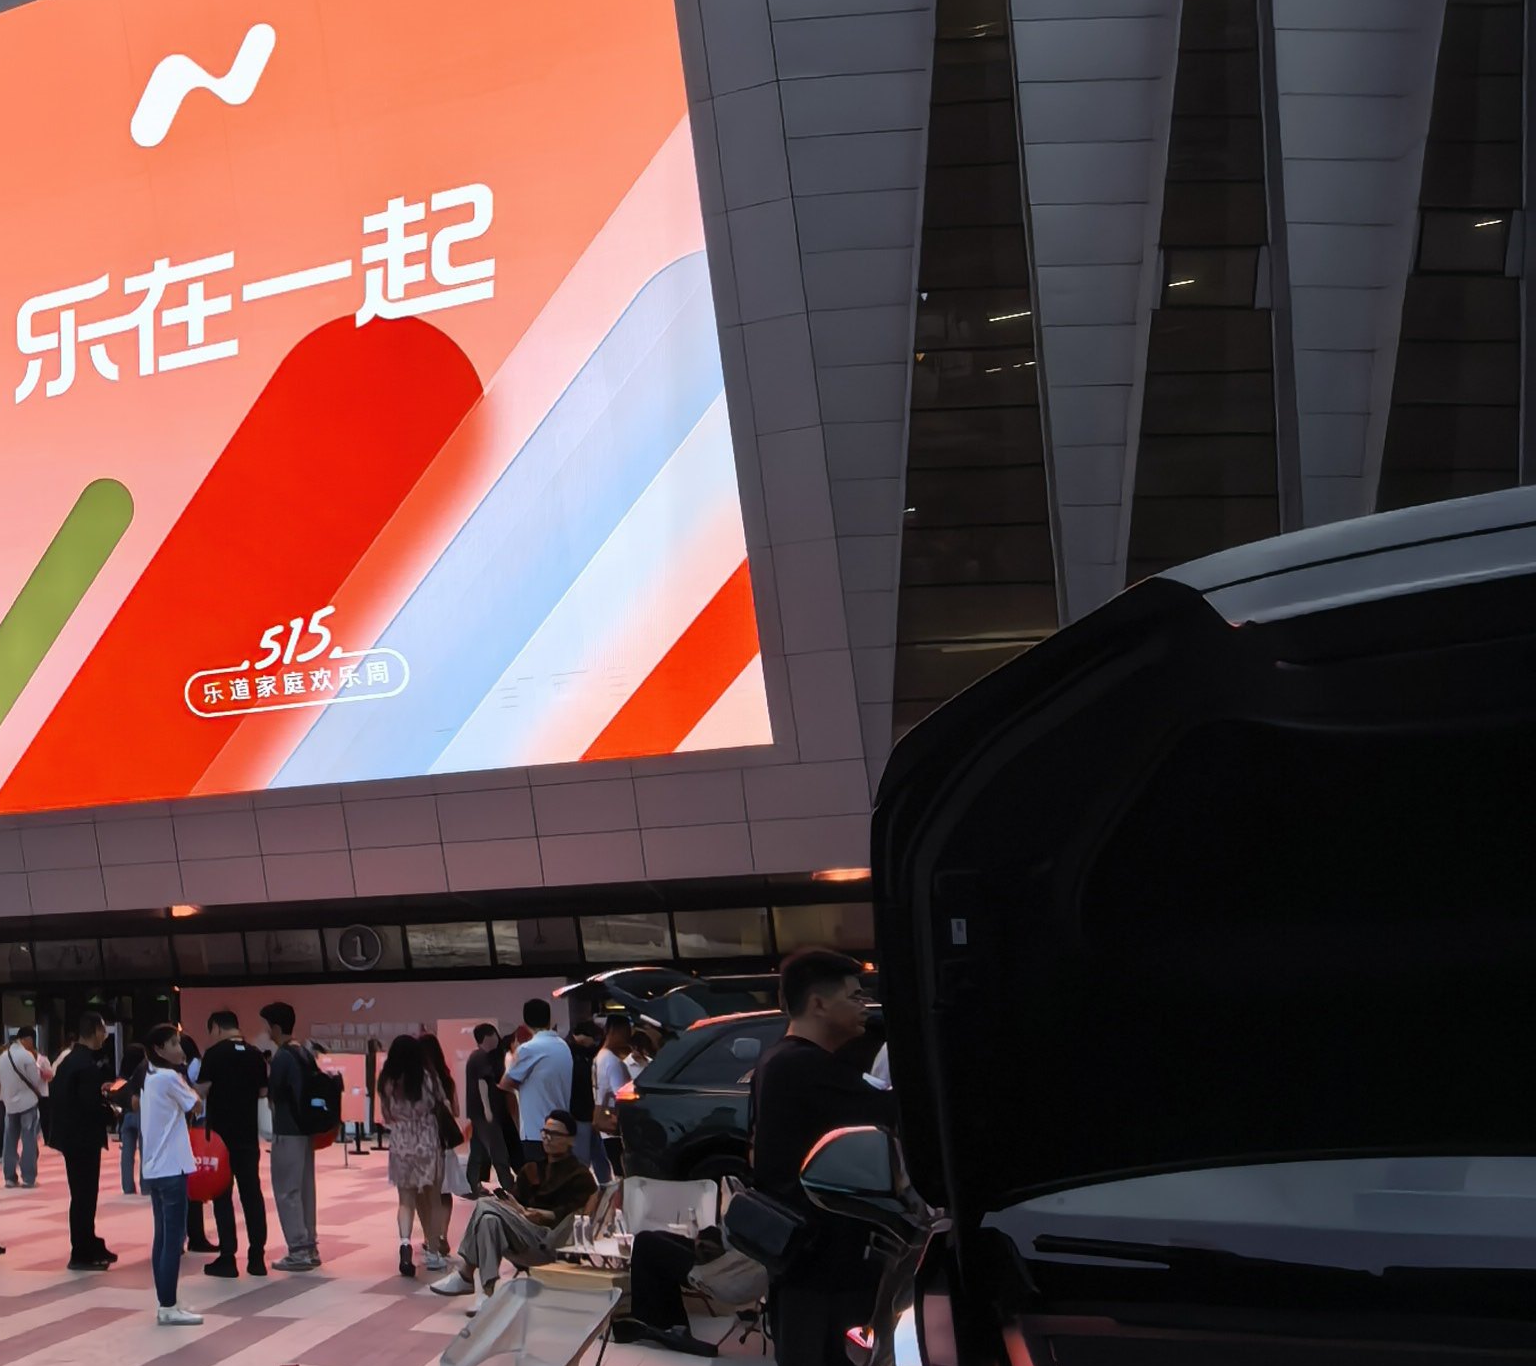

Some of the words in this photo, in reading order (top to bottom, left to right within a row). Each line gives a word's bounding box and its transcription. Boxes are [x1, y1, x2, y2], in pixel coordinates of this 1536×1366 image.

[15, 183, 495, 404] 乐在一起
[254, 605, 336, 670] 515
[203, 659, 389, 704] 乐道家庭欢乐周
[351, 935, 366, 961] 1
